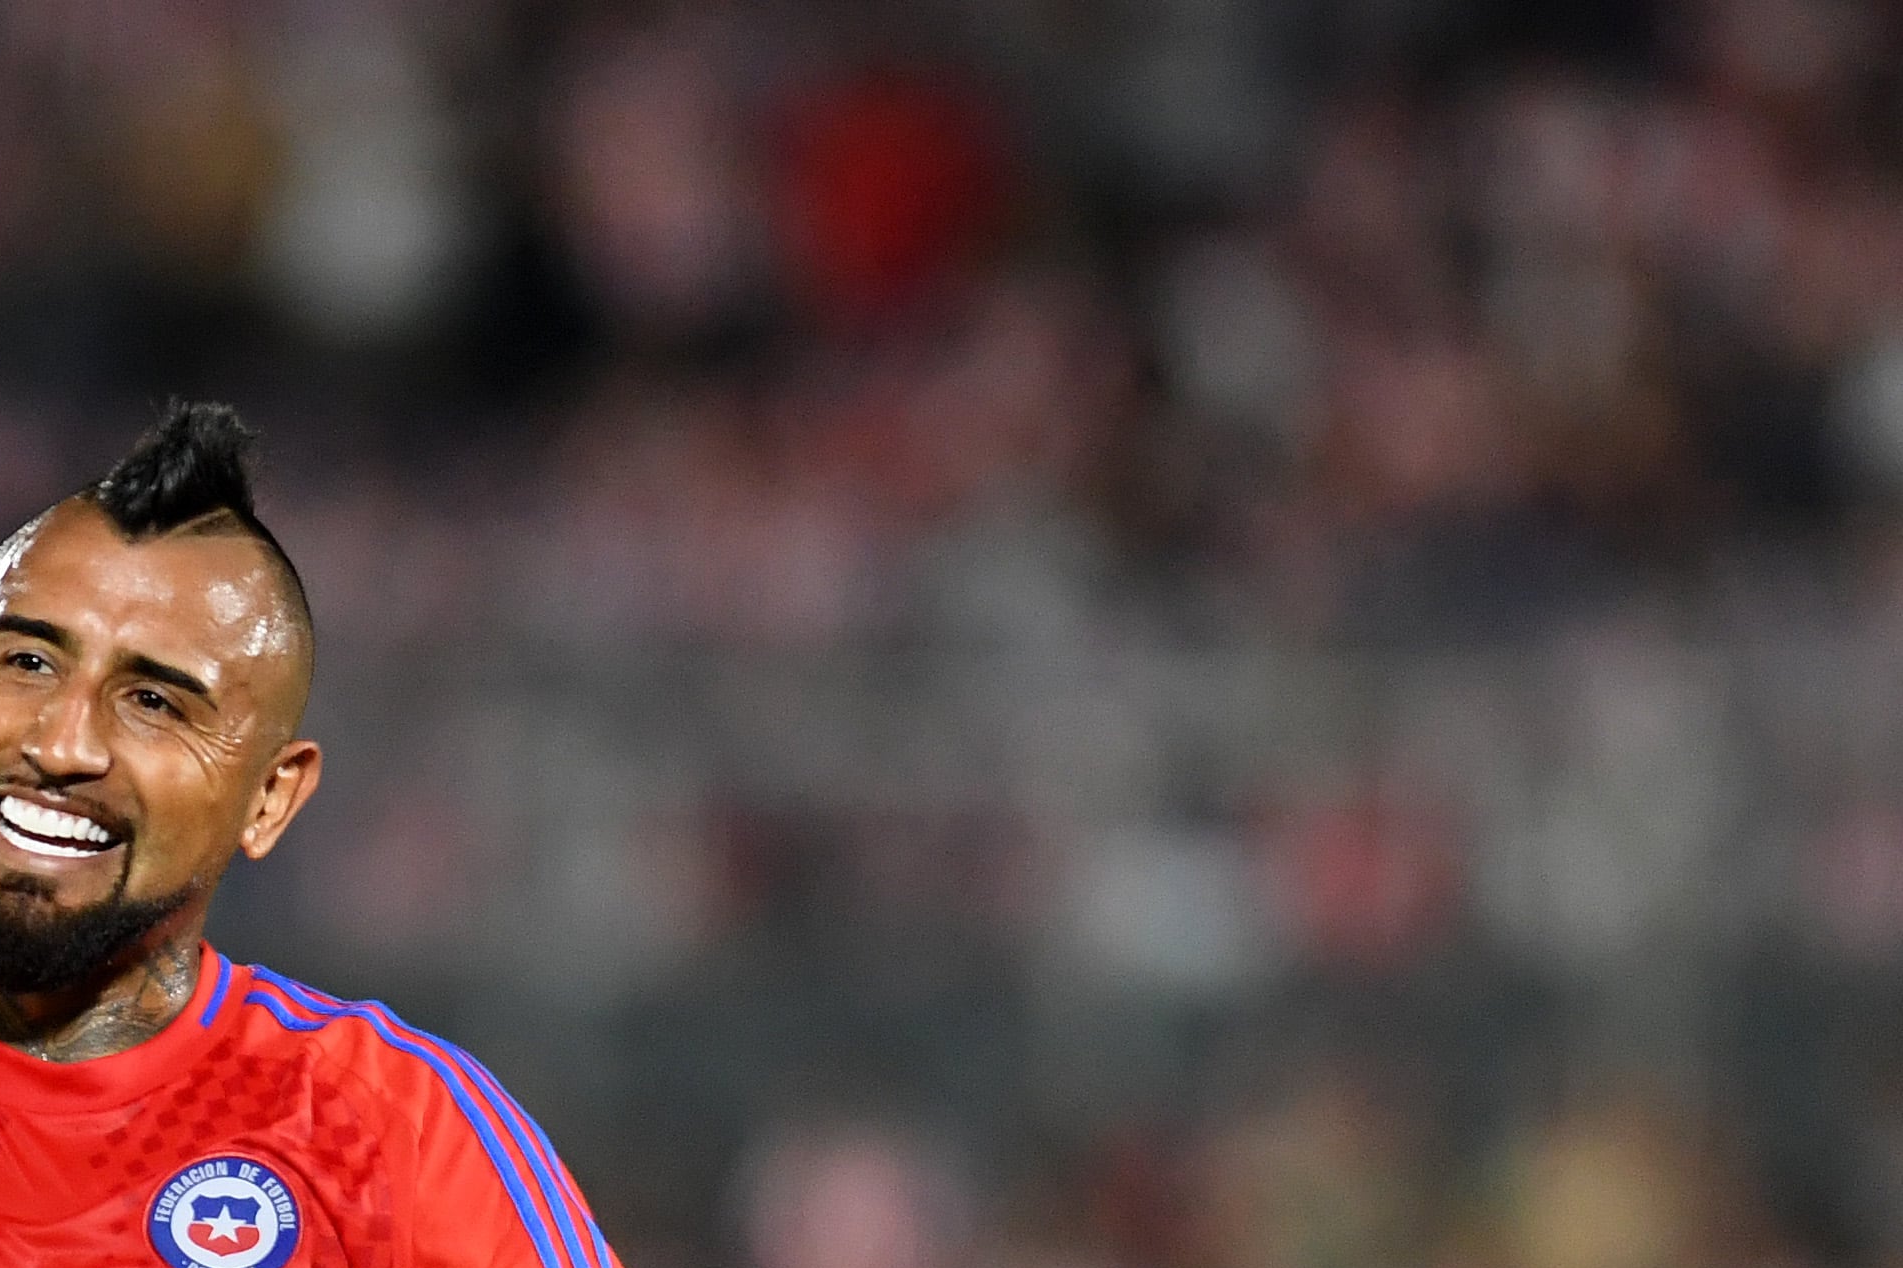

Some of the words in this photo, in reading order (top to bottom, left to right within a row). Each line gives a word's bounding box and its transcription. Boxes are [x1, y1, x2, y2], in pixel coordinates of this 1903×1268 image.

[154, 1161, 227, 1222] FEDERACION
[238, 1163, 259, 1182] DE
[262, 1178, 296, 1231] FUTBOL
